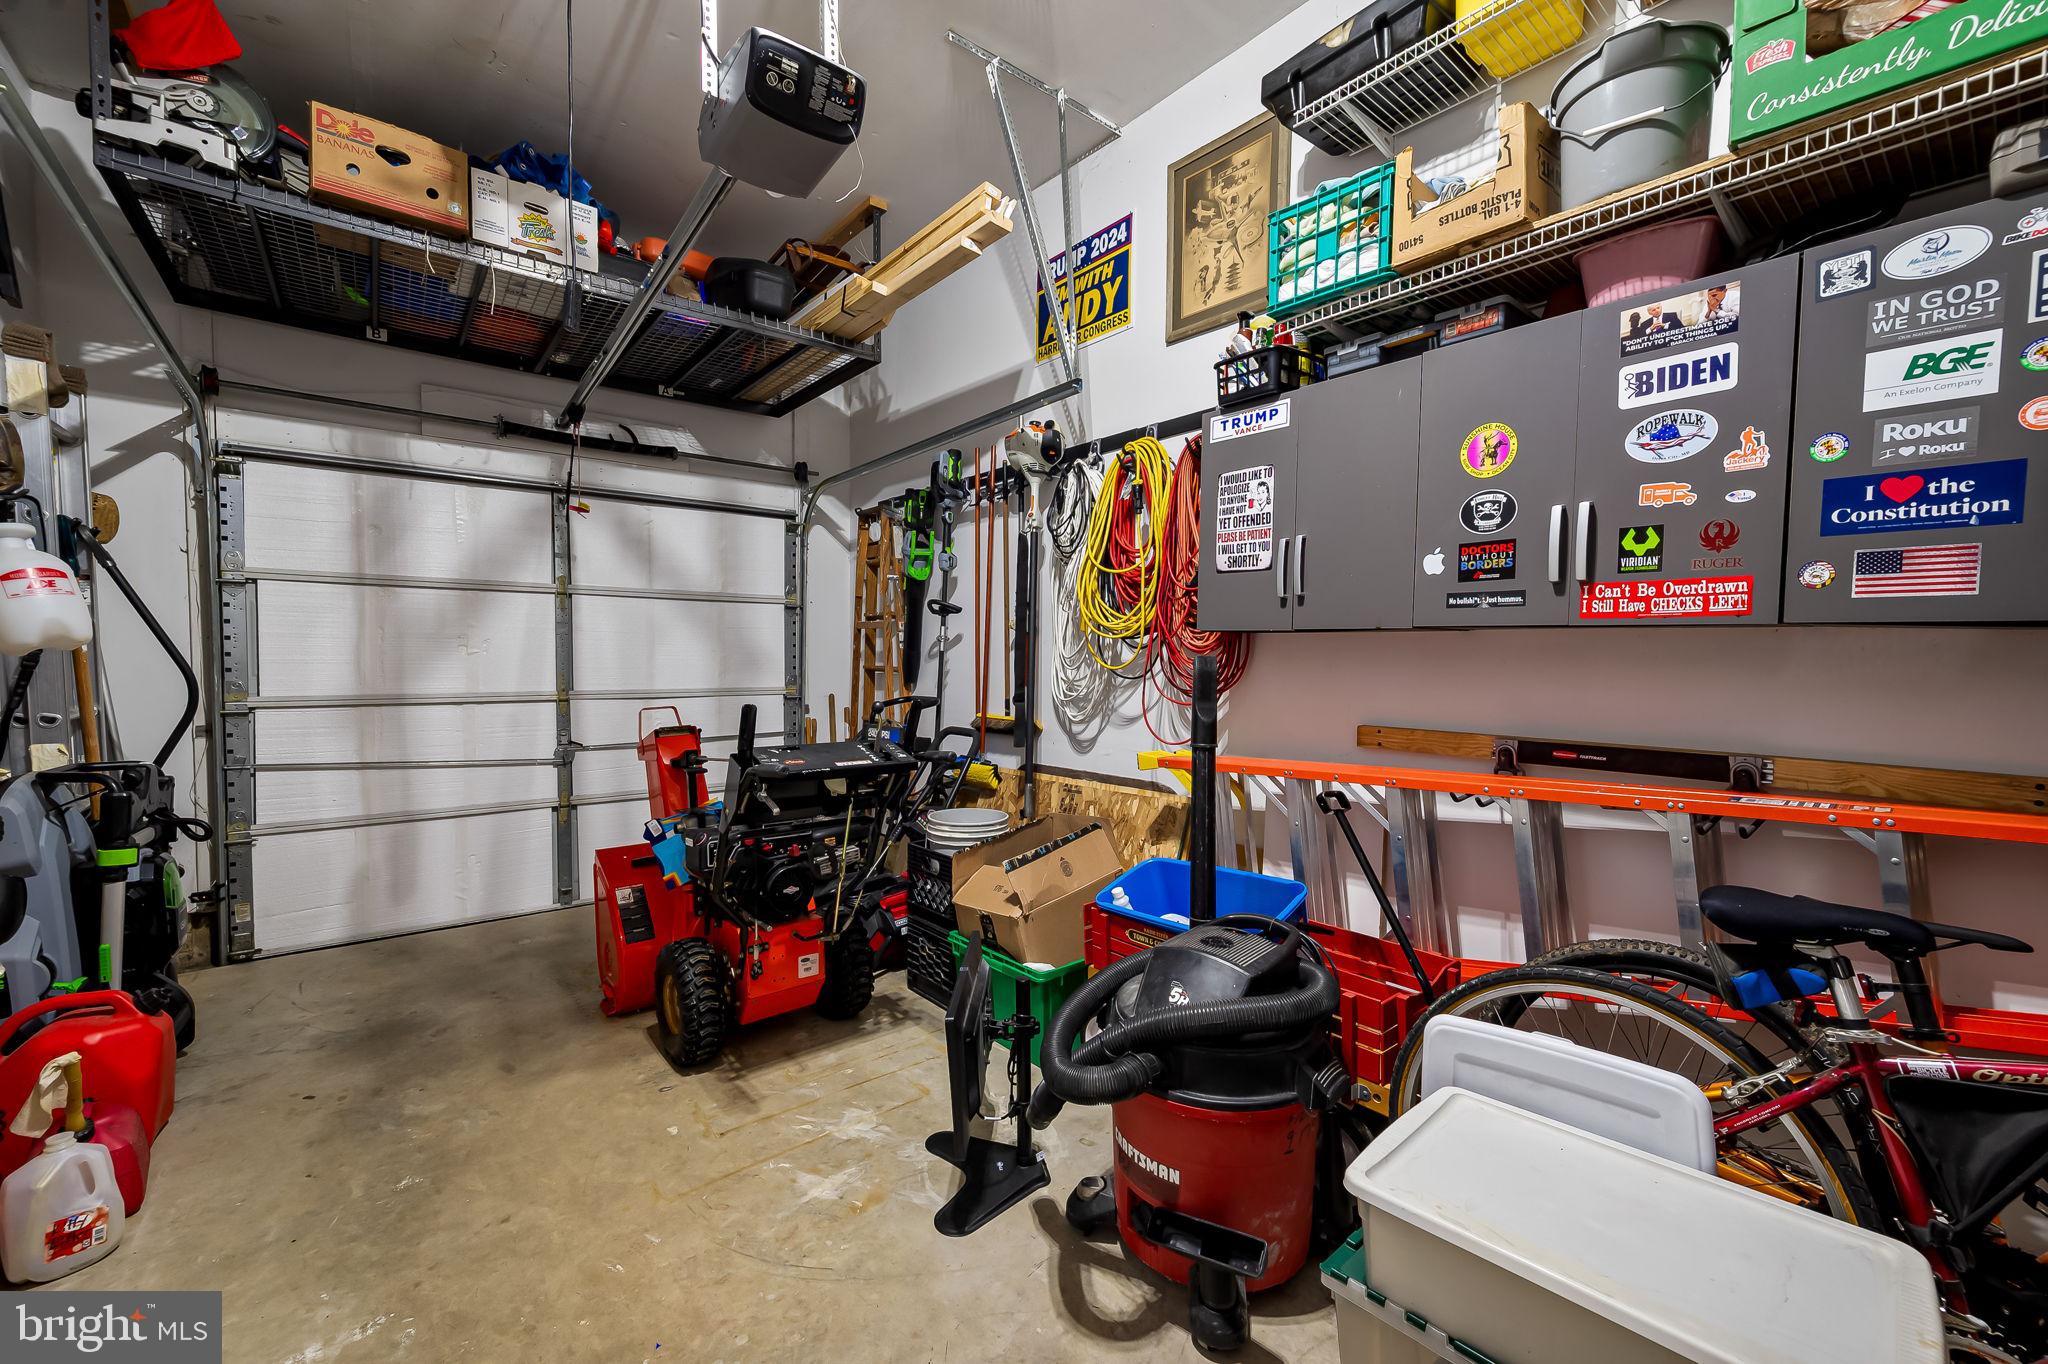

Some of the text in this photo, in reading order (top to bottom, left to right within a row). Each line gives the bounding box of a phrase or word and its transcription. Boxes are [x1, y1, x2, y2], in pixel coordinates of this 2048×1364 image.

[1753, 42, 1788, 63] Fresh
[1747, 37, 1933, 121] Consistently,
[316, 134, 375, 159] BANANAS
[1481, 189, 1522, 210] PLASTIC
[1439, 206, 1478, 227] BOTTLES
[520, 221, 556, 240] Fresh
[1091, 222, 1127, 259] 2024
[1398, 235, 1424, 252] 54100
[1075, 260, 1115, 293] WITH
[1874, 279, 2000, 320] IN GOD
[1872, 297, 2002, 334] WE TRUST
[1083, 311, 1129, 342] CONGRESS
[1649, 319, 1713, 339] UNDERESTIMATE
[1625, 340, 1654, 352] ABILITY
[1685, 327, 1714, 338] THINGS
[1902, 341, 1996, 381] BGE
[1635, 352, 1731, 398] BIDEN
[1884, 377, 1984, 399] An Exelon Company
[1221, 408, 1279, 431] TRUMP
[1235, 424, 1263, 435] VANCE
[1636, 412, 1707, 440] ROPEWALK
[1463, 424, 1515, 450] SUNSHINE HOUSE
[1224, 472, 1247, 485] WOULD
[1248, 469, 1262, 481] LIKE
[1264, 467, 1273, 478] TO
[1220, 483, 1250, 497] APOLOGIZE
[1227, 494, 1247, 505] ANYONE
[1864, 477, 1975, 502] I the
[1222, 506, 1235, 516] HAVE
[1236, 505, 1247, 514] NOT
[1831, 497, 2010, 524] Constitution
[1219, 512, 1271, 530] YET OFFENDED
[1217, 528, 1271, 543] PLEASE BE PATIENT
[1221, 543, 1235, 555] WILL
[1236, 543, 1247, 554] GET
[1249, 542, 1256, 553] TO
[1258, 541, 1270, 552] YOU
[1461, 543, 1514, 556] DOCTORS
[1461, 551, 1514, 561] WITHOUT
[1460, 558, 1514, 571] BORDERS
[1621, 556, 1658, 567] VIRIDIAN
[1692, 557, 1743, 569] RUGER
[26, 579, 57, 590] ACE
[1583, 580, 1748, 598] I Can't Be Overdrawn
[1582, 594, 1748, 613] I Still Have CHECKS LEFT!
[1133, 933, 1149, 943] TOWN
[1116, 1126, 1180, 1185] CRAFTSMAN
